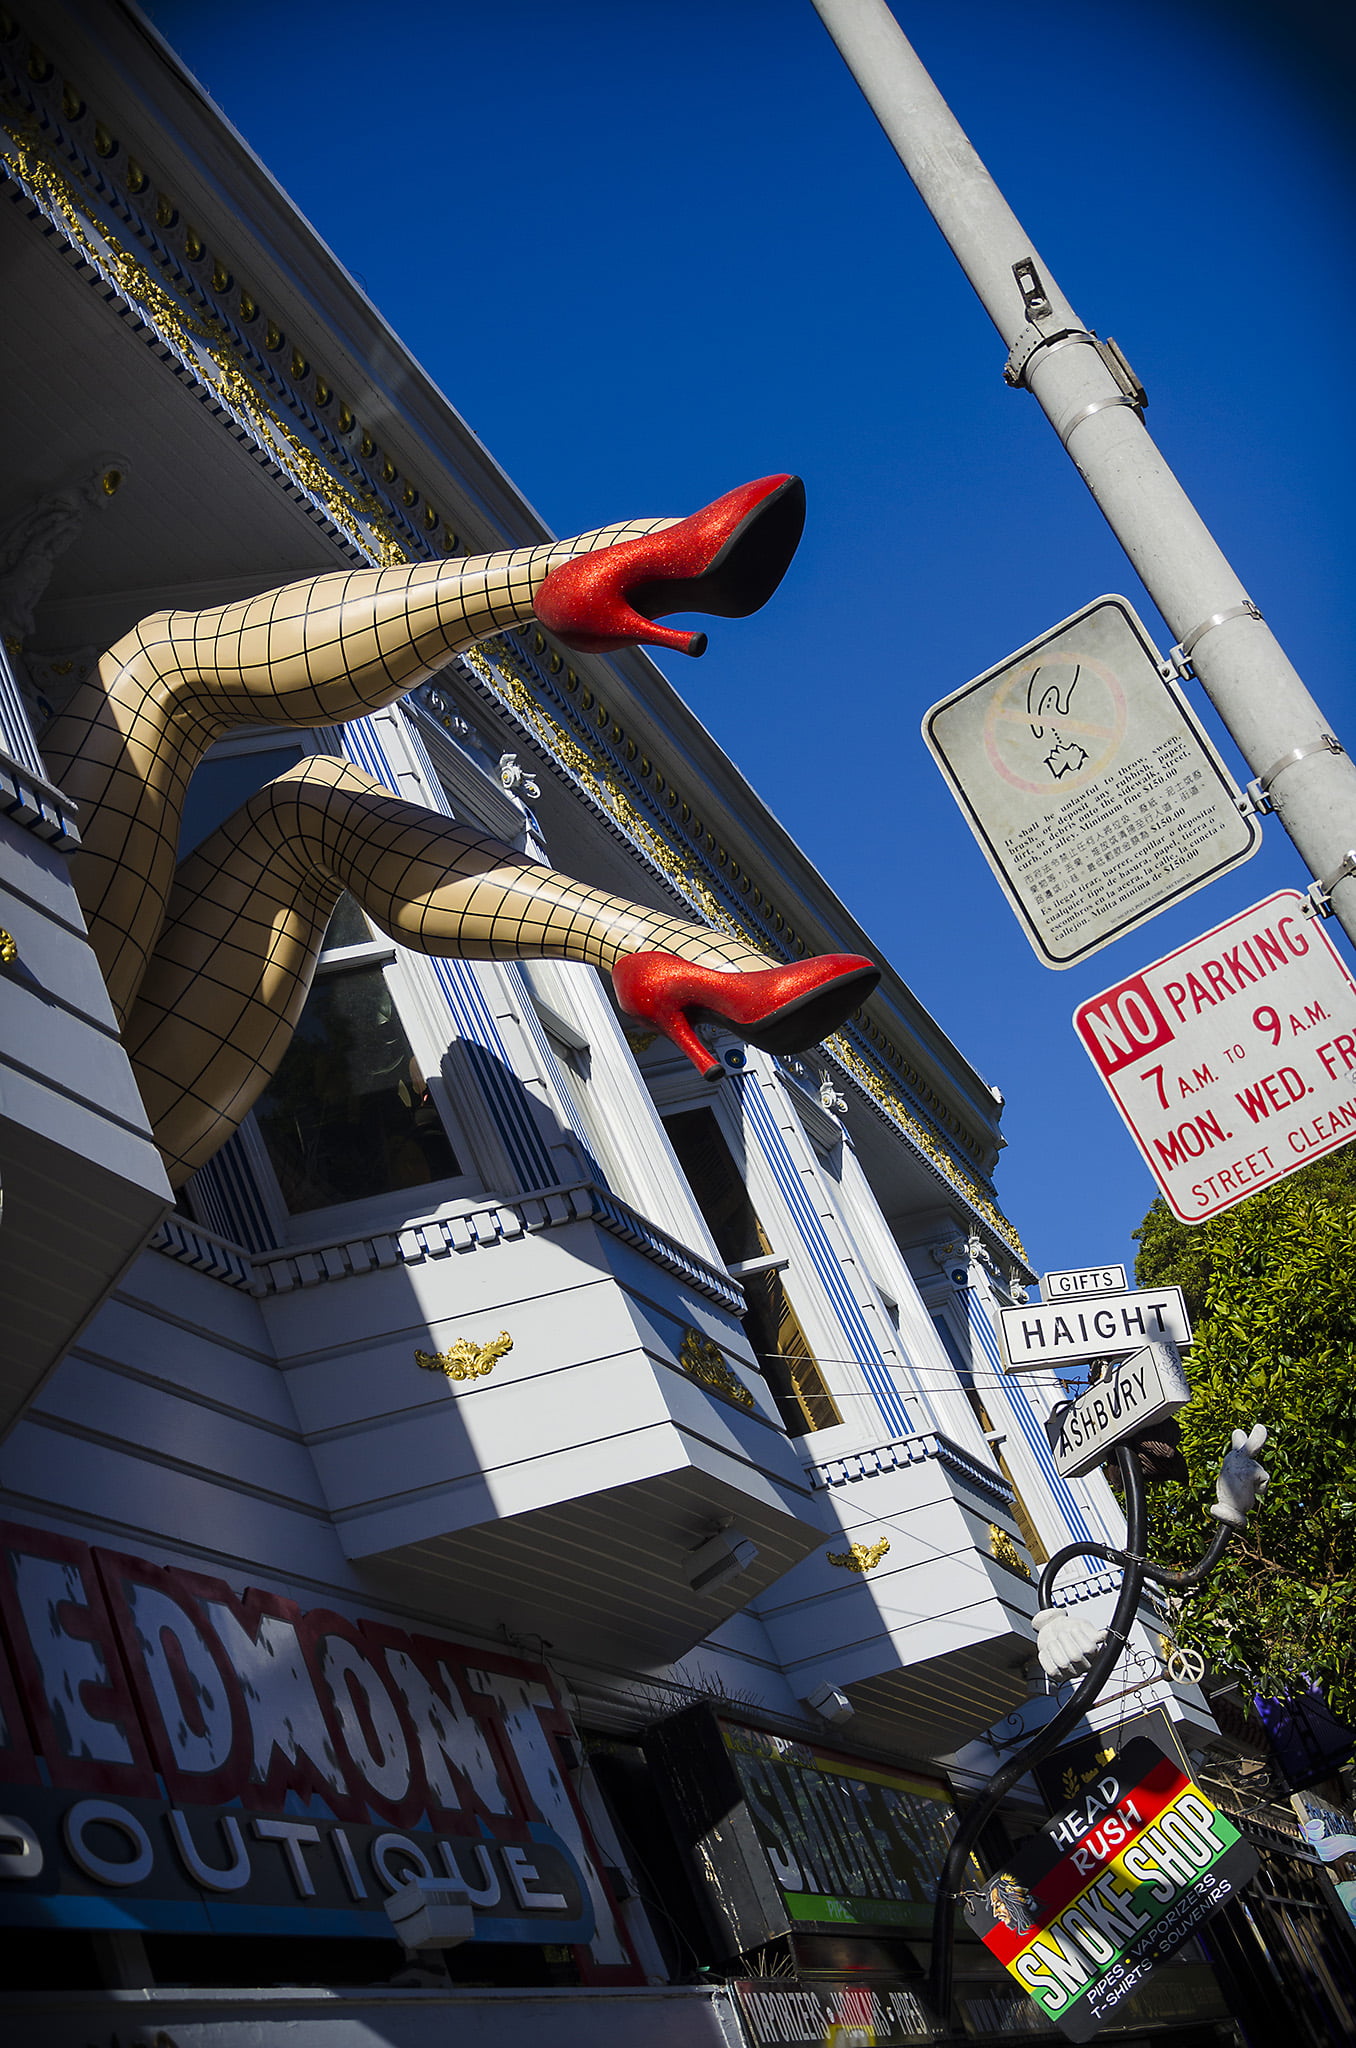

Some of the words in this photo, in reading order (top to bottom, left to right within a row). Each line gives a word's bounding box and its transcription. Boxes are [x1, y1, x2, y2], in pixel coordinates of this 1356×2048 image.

[1004, 839, 1013, 847] It
[1018, 821, 1040, 838] shall
[1043, 813, 1055, 822] be
[1060, 784, 1099, 812] unlawful
[1104, 776, 1114, 785] to
[1036, 840, 1045, 849] or
[1049, 819, 1076, 841] debris
[1078, 807, 1099, 823] onto
[1100, 796, 1115, 809] the
[1042, 825, 1052, 835] or
[1057, 802, 1089, 825] deposit
[1094, 790, 1110, 802] any
[1043, 846, 1053, 856] or
[1079, 804, 1123, 833] Minimum
[1123, 792, 1142, 806] fine
[1142, 768, 1178, 794] $150.00
[1150, 807, 1186, 833] $150.00
[1040, 907, 1052, 916] Es
[1053, 889, 1077, 908] ilegal
[1134, 835, 1165, 859] cepillar
[1177, 804, 1216, 832] depositar
[1046, 897, 1084, 924] cualquier
[1087, 886, 1104, 899] tipo
[1107, 878, 1117, 887] de
[1181, 823, 1207, 841] tierra
[1050, 905, 1093, 933] escombros
[1094, 897, 1105, 906] en
[1105, 891, 1116, 899] la
[1143, 867, 1153, 876] la
[1178, 846, 1188, 854] la
[1189, 828, 1218, 848] cuneta
[1091, 900, 1118, 919] Multa
[1152, 872, 1162, 882] de
[1163, 848, 1199, 875] $150.00
[1085, 989, 1160, 1064] NO
[1162, 916, 1310, 1023] PARKING
[1139, 1064, 1171, 1111] 7
[1177, 1063, 1219, 1099] A.M.
[1223, 1043, 1247, 1064] TO
[1252, 1005, 1283, 1047] 9
[1289, 1000, 1332, 1037] A.M.
[1153, 1109, 1234, 1172] MON.
[1234, 1066, 1315, 1124] WED.
[1315, 1030, 1356, 1081] FR
[1191, 1146, 1275, 1208] STREET
[1288, 1098, 1356, 1154] CLEAN
[1022, 1303, 1168, 1350] HAIGHT
[1060, 1272, 1114, 1292] GIFTS
[1059, 1366, 1149, 1459] ASHBURY
[0, 1550, 632, 1967] EDMONT
[1049, 1776, 1121, 1852] HEAD
[1069, 1799, 1143, 1877] RUSH
[1016, 1869, 1151, 2011] SMOKE
[1123, 1794, 1225, 1906] SHOP
[1086, 1963, 1126, 2004] PIPES
[1130, 1873, 1217, 1957] VAPORIZERS
[1090, 1958, 1154, 2020] T-SHIRTS
[1158, 1878, 1233, 1954] SOUVENIRS
[743, 1991, 832, 2043] VAPORIZERS
[889, 1991, 928, 2035] PIPES
